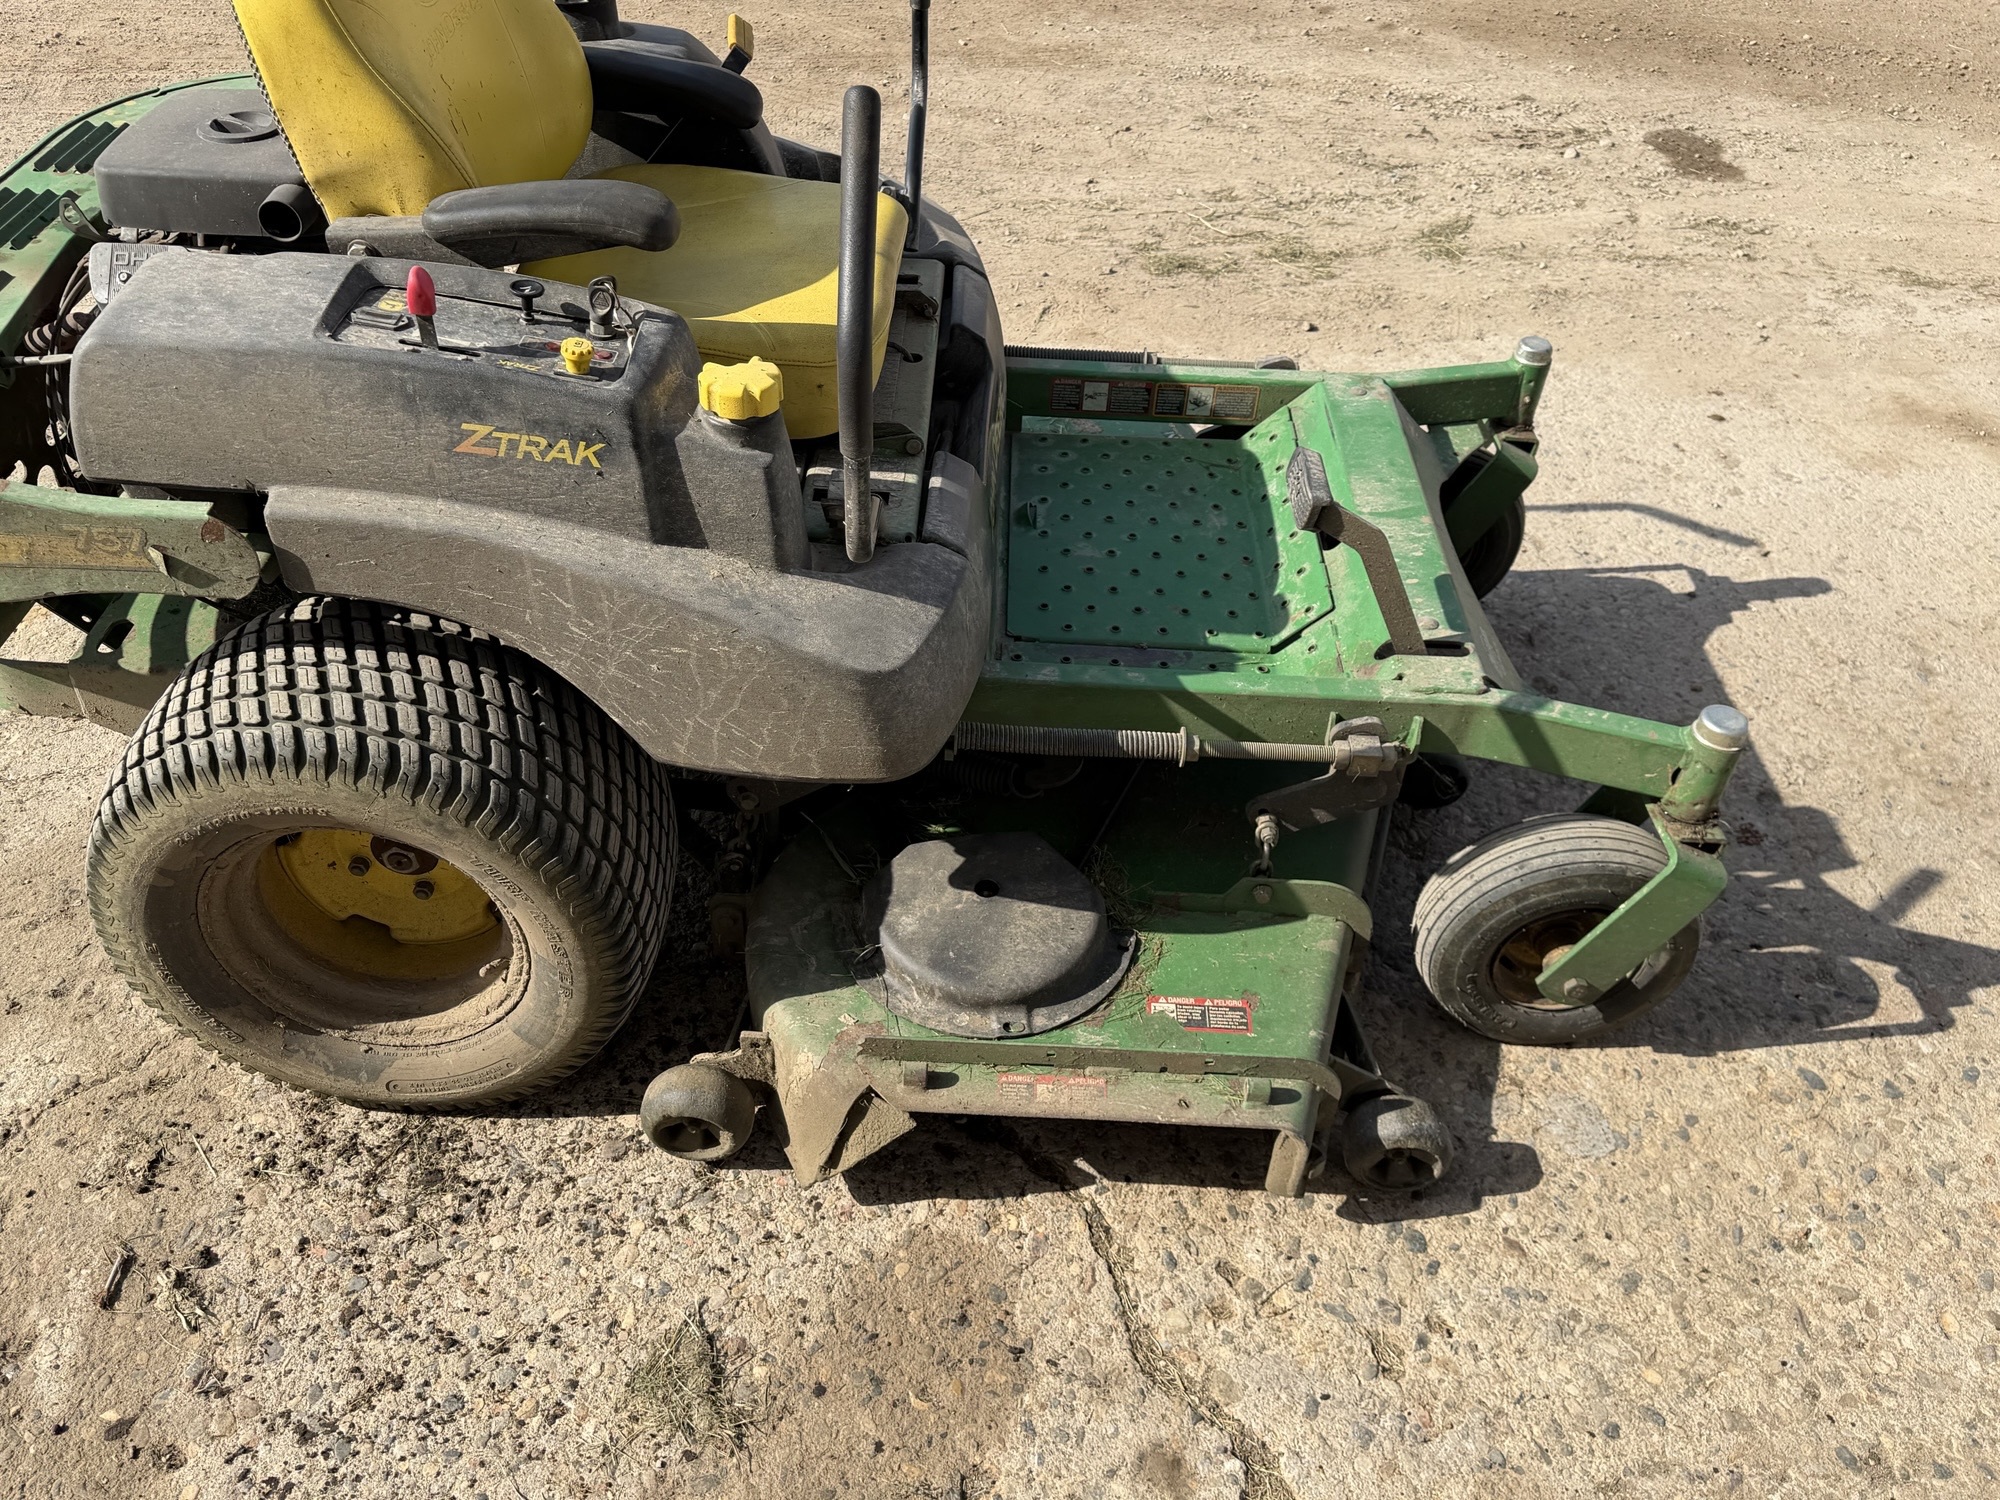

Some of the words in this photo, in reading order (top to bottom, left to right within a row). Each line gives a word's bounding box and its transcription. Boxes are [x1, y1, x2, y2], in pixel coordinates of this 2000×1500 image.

[453, 423, 605, 468] ZTRAK
[144, 942, 245, 1043] CARLISLE
[1167, 997, 1195, 1005] DANGER
[1213, 999, 1243, 1007] PELIGRO
